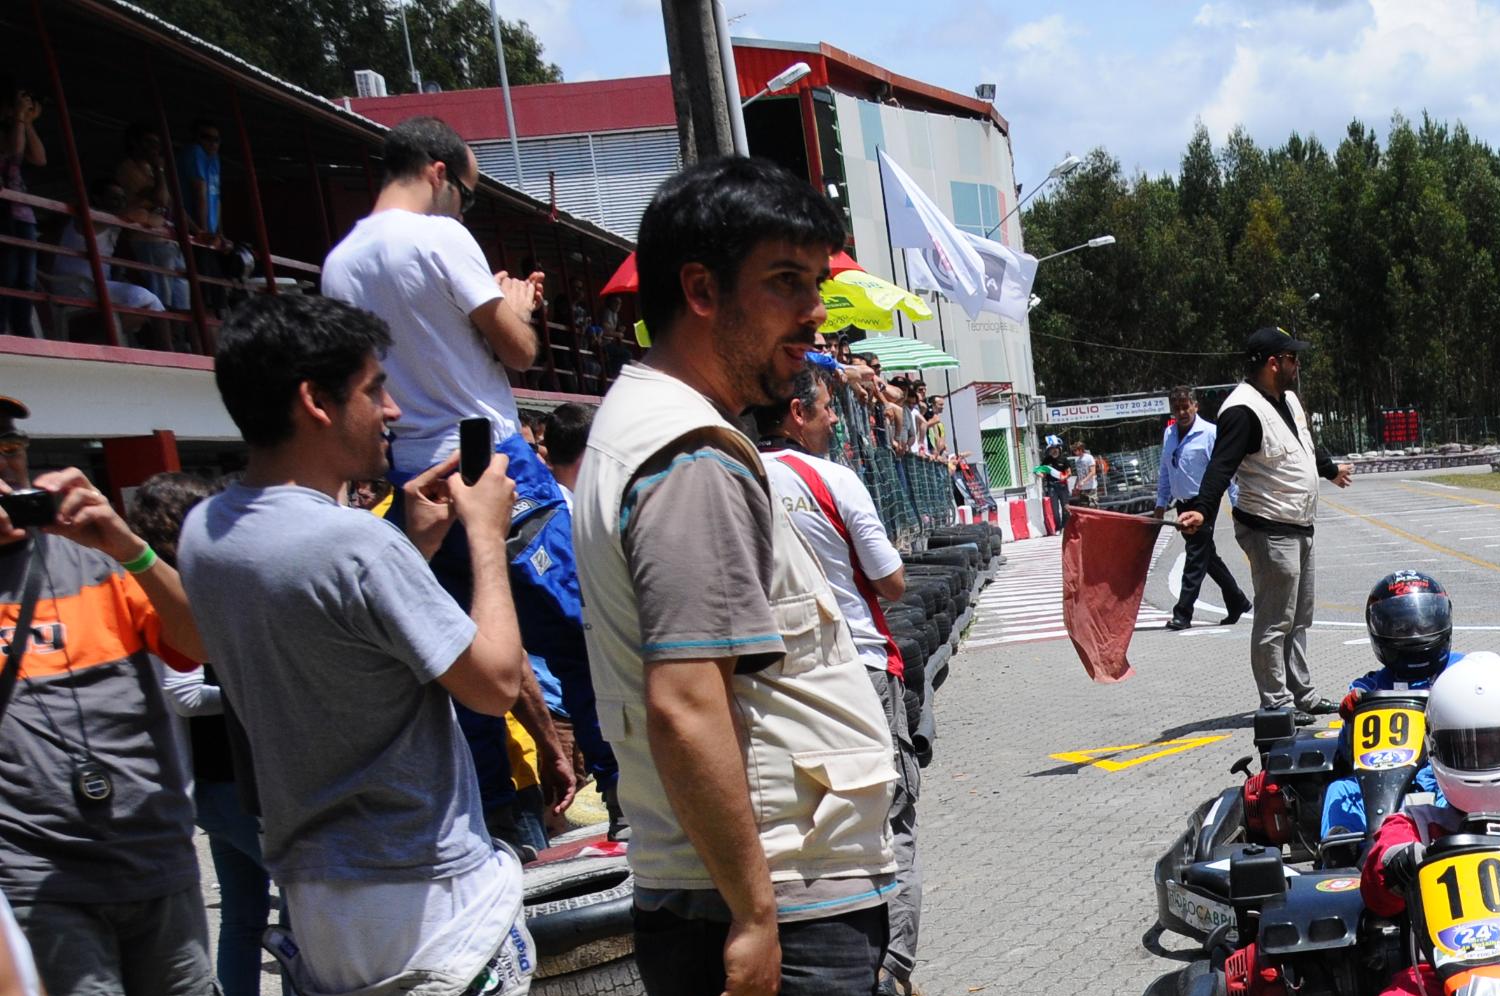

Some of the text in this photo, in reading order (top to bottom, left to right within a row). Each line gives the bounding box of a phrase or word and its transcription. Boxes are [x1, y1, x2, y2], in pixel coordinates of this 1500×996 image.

[1155, 400, 1165, 408] 25
[1361, 712, 1410, 750] 99
[1460, 924, 1493, 944] 24
